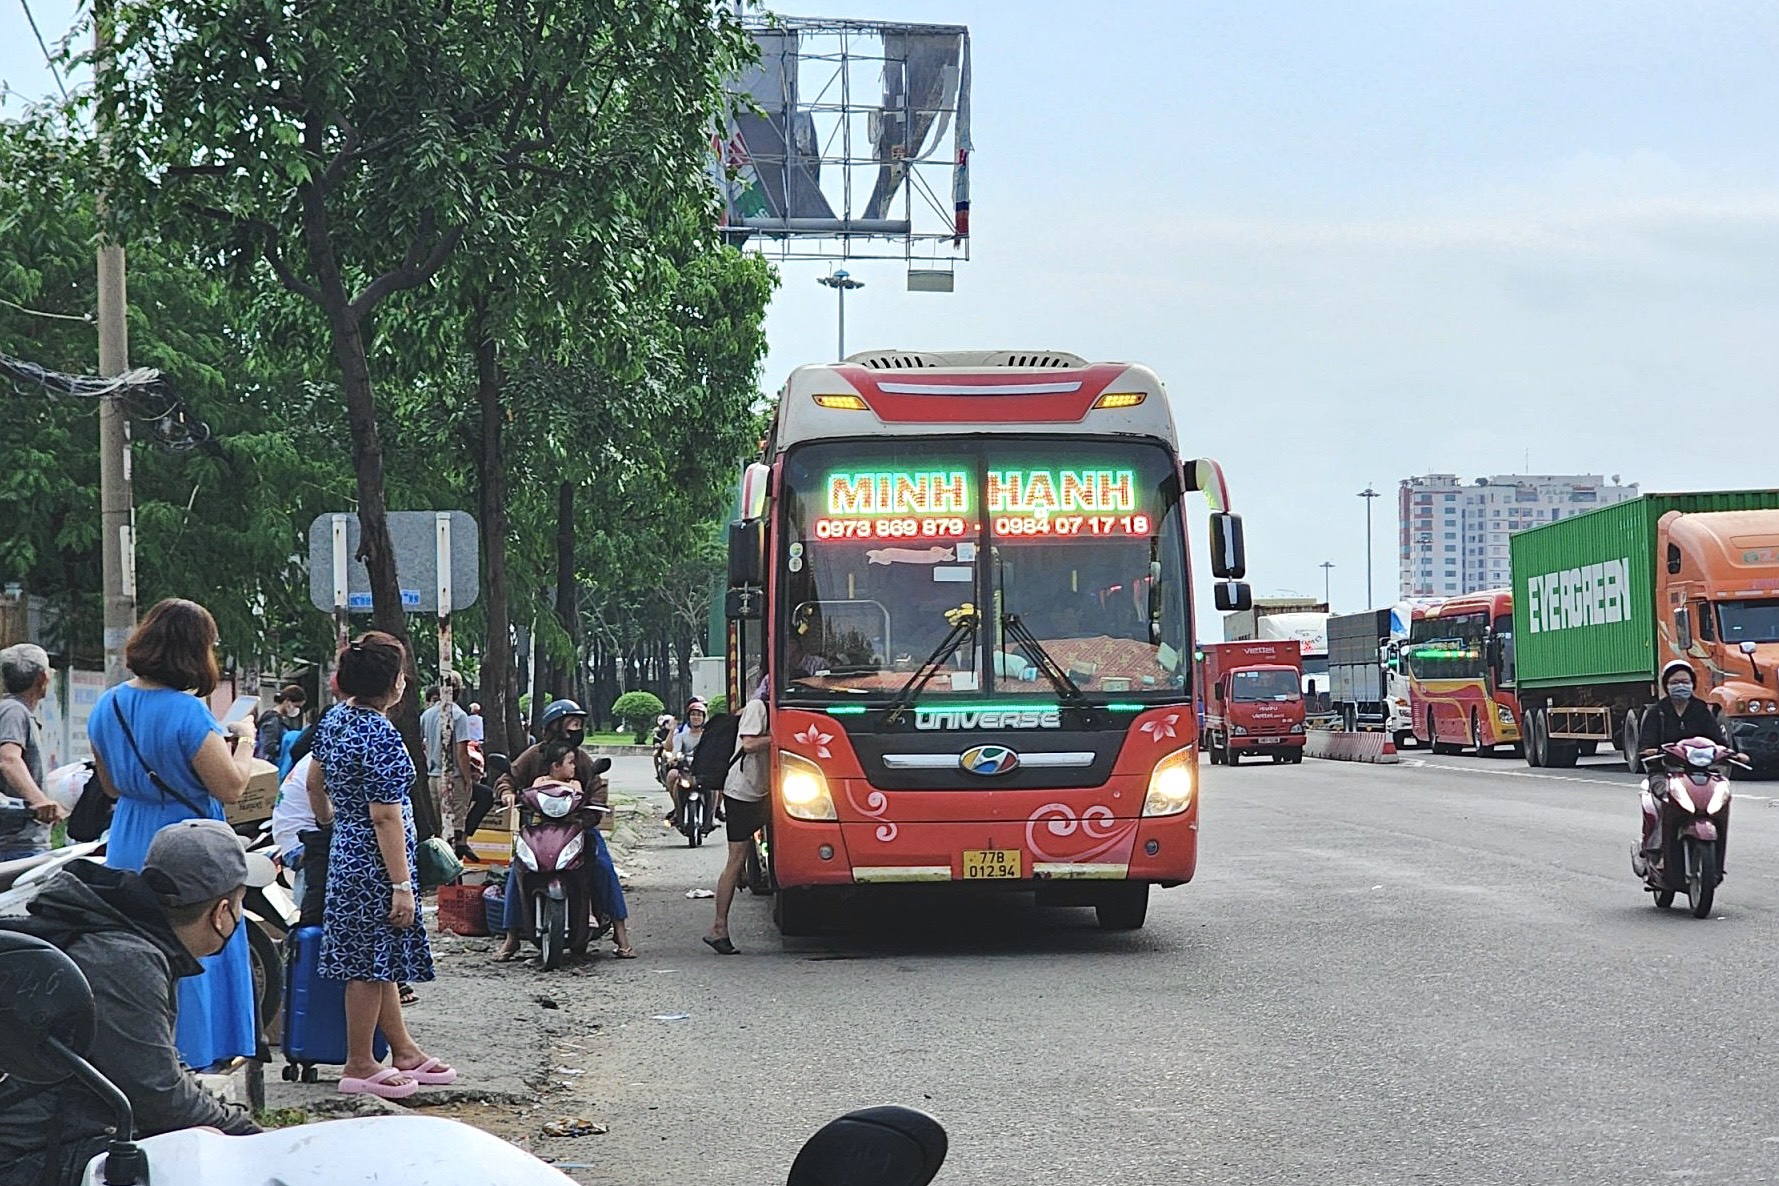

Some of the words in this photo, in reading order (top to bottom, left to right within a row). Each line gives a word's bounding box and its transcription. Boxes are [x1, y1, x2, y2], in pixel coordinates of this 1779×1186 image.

[828, 472, 968, 514] MINH
[988, 471, 1135, 518] HẠNH
[816, 519, 871, 538] 0973
[876, 518, 918, 537] 869
[922, 517, 965, 536] 879
[995, 516, 1050, 535] 0984
[1055, 516, 1083, 534] 07
[1088, 516, 1115, 534] 17
[1120, 515, 1150, 533] 18
[1528, 557, 1631, 634] EVERGREEN
[914, 711, 1061, 730] UNIVERSE
[979, 851, 1005, 864] 77B
[969, 864, 1015, 878] 012.94
